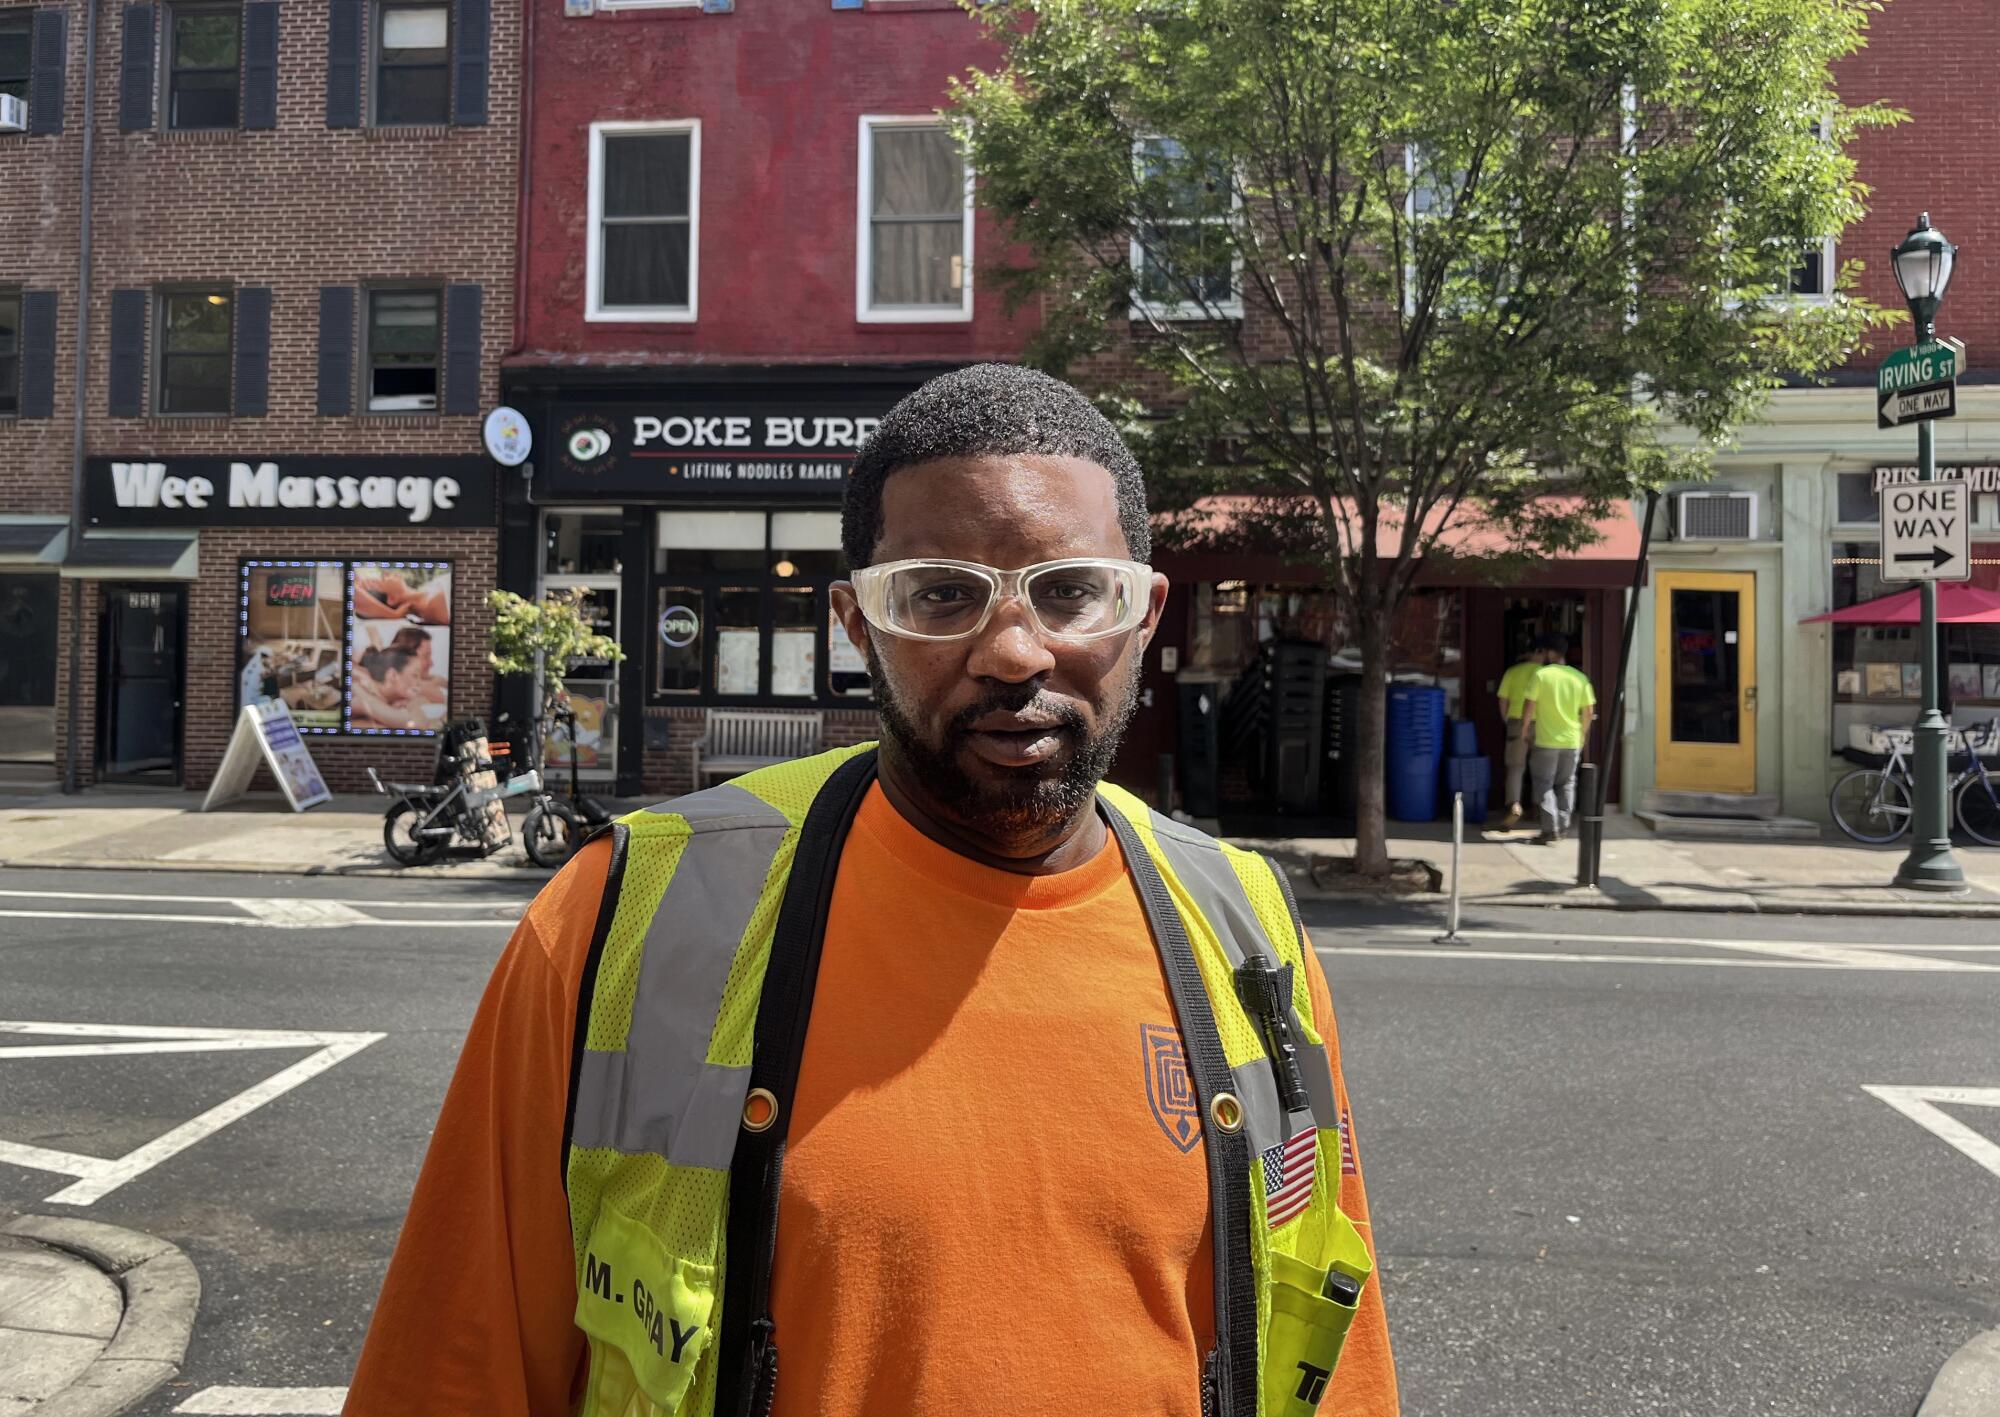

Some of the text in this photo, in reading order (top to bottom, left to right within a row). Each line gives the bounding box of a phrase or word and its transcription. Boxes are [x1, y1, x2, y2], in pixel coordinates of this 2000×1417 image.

[1909, 345, 1918, 359] W
[1880, 358, 1954, 390] IRVING ST
[1899, 391, 1946, 414] ONE WAY
[633, 416, 751, 447] POKE
[683, 463, 842, 479] LIFTING NOODLES RAMEN
[111, 462, 461, 522] Wee Massage
[1893, 490, 1957, 513] ONE
[1893, 517, 1955, 538] WAY
[271, 583, 313, 599] OPEN
[663, 619, 696, 633] OPEN
[585, 1252, 700, 1364] M. GRAY
